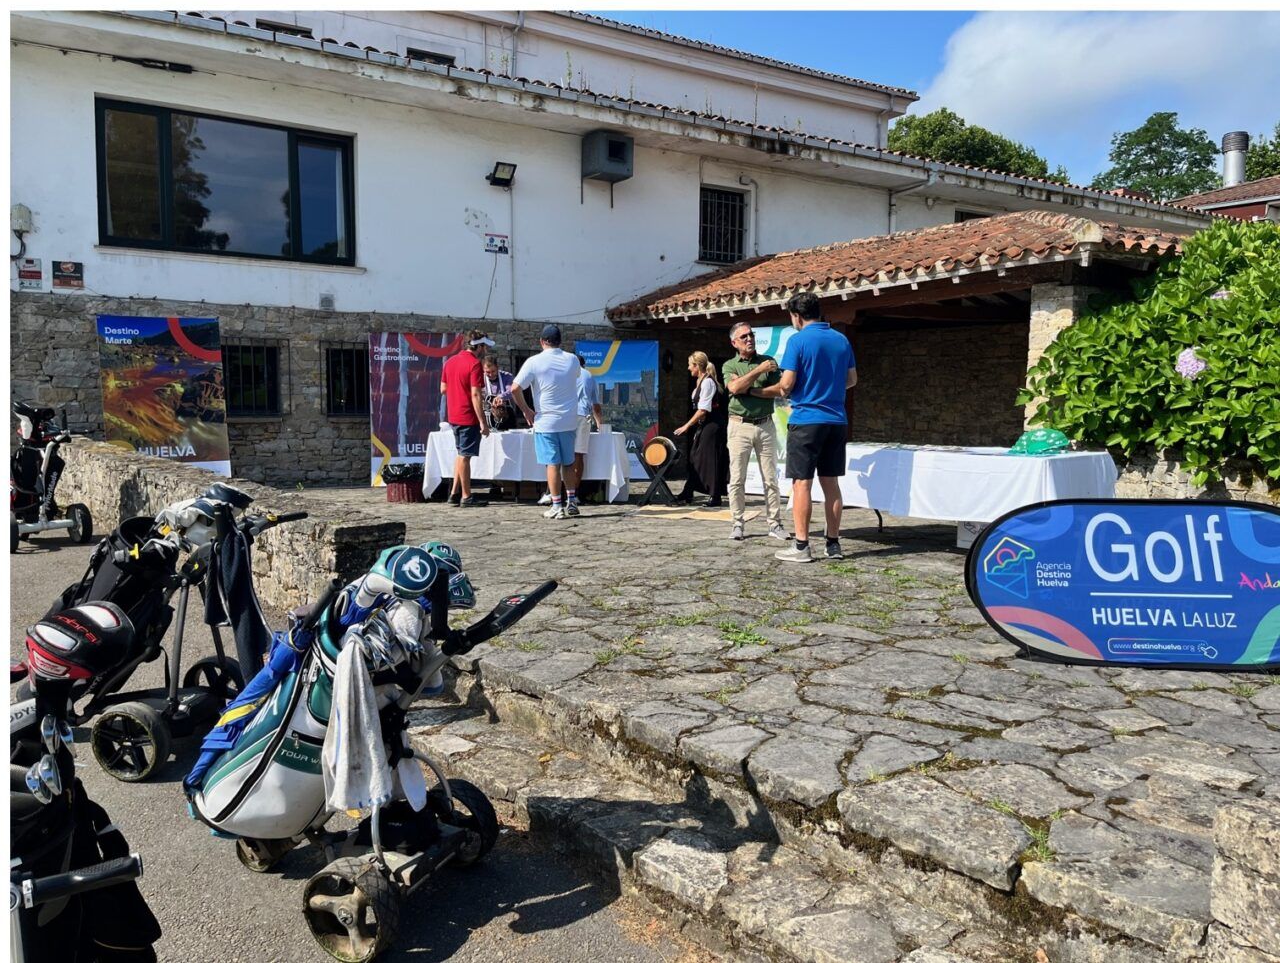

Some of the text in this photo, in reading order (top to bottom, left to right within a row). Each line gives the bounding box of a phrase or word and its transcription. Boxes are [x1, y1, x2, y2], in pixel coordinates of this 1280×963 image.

[104, 326, 140, 335] Destino
[105, 337, 133, 345] Marte
[373, 346, 401, 354] Destino
[1084, 512, 1224, 584] Golf
[1036, 561, 1072, 572] Agencia
[1036, 570, 1072, 579] Destino
[1036, 578, 1069, 587] Huelva
[1092, 607, 1177, 627] HUELVA
[1113, 642, 1196, 652] www.destinohuelva.org
[280, 748, 308, 763] TOUR
